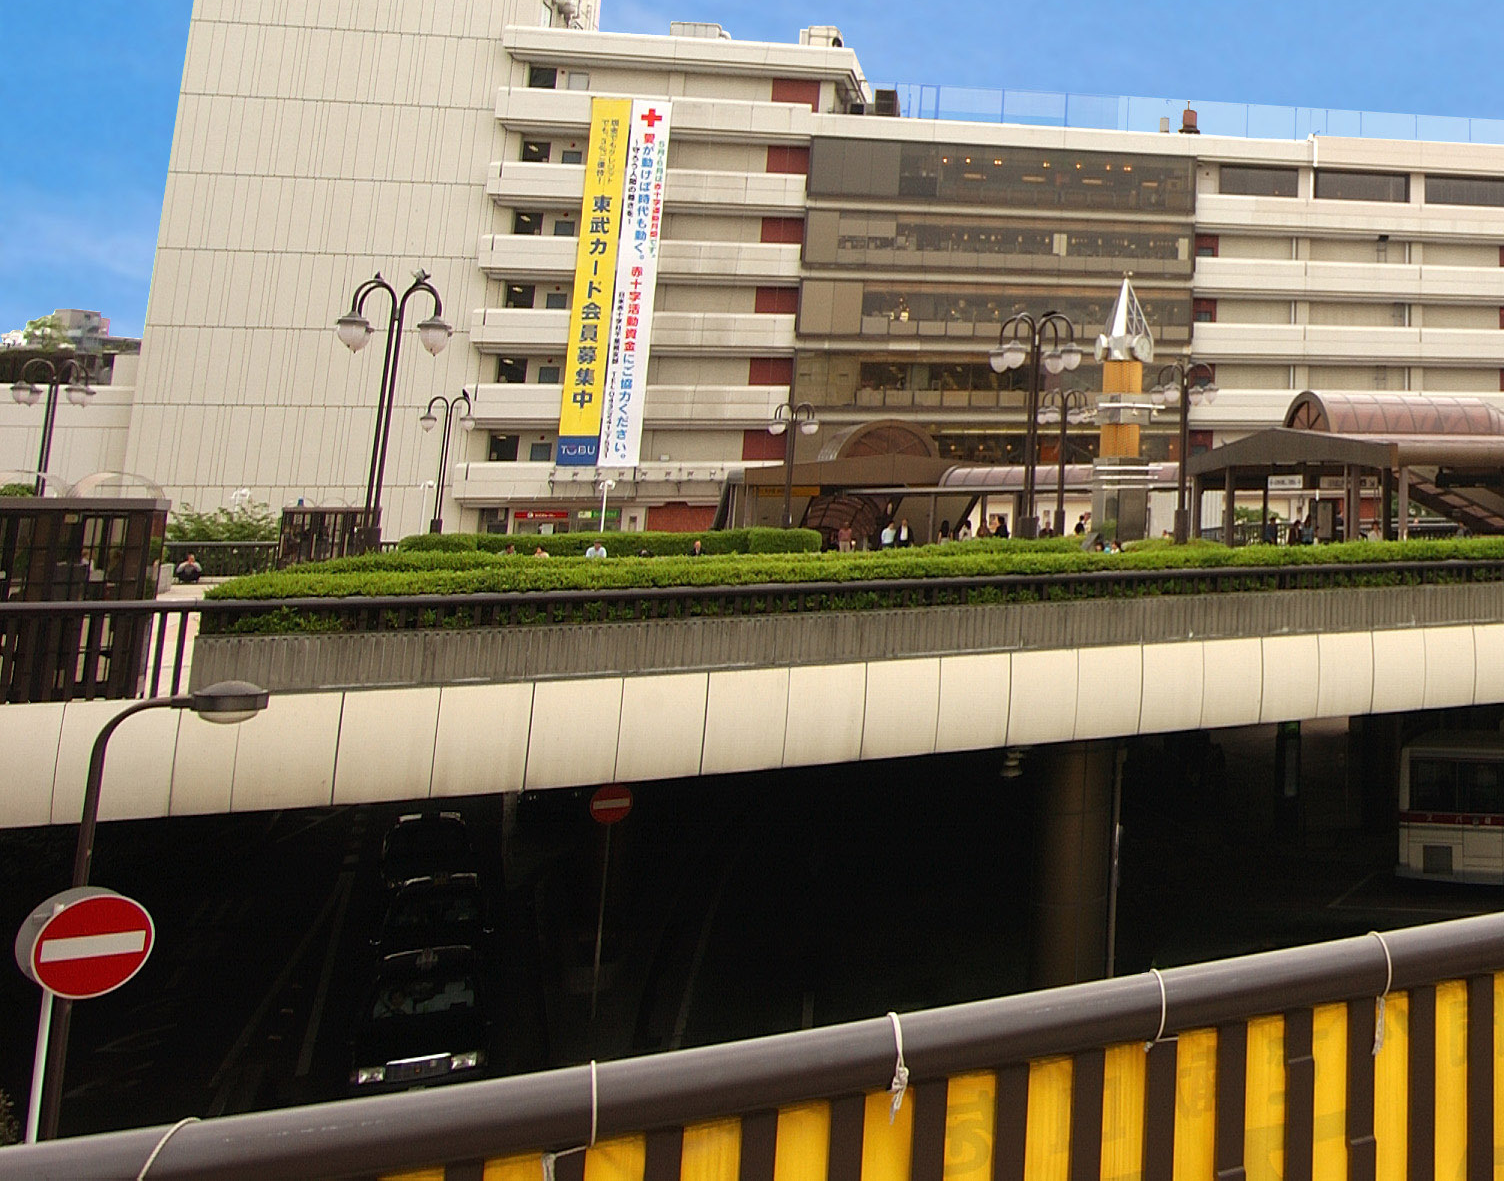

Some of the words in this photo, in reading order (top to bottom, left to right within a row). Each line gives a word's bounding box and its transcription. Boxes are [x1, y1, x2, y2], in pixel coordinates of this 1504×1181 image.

[572, 195, 613, 409] 東武カード会員募集中
[560, 445, 596, 456] TOBU
